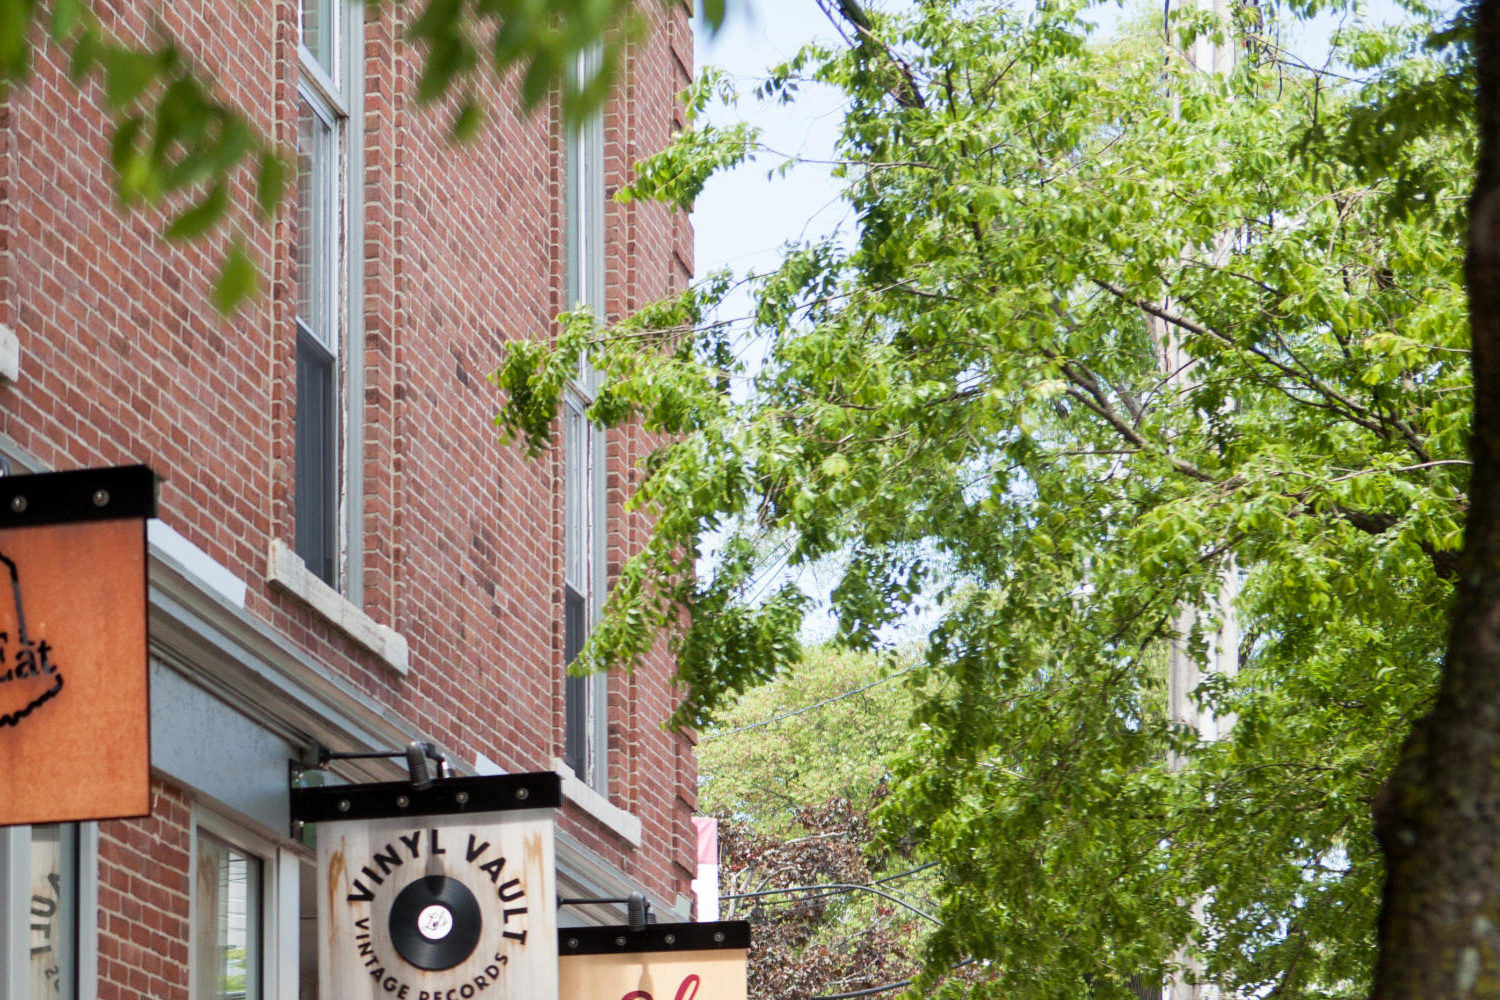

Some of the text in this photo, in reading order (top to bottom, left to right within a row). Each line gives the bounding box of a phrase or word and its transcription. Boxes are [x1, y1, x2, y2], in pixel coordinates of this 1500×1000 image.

[347, 829, 529, 946] VINYL VAULT
[354, 916, 410, 1000] VINTAGE
